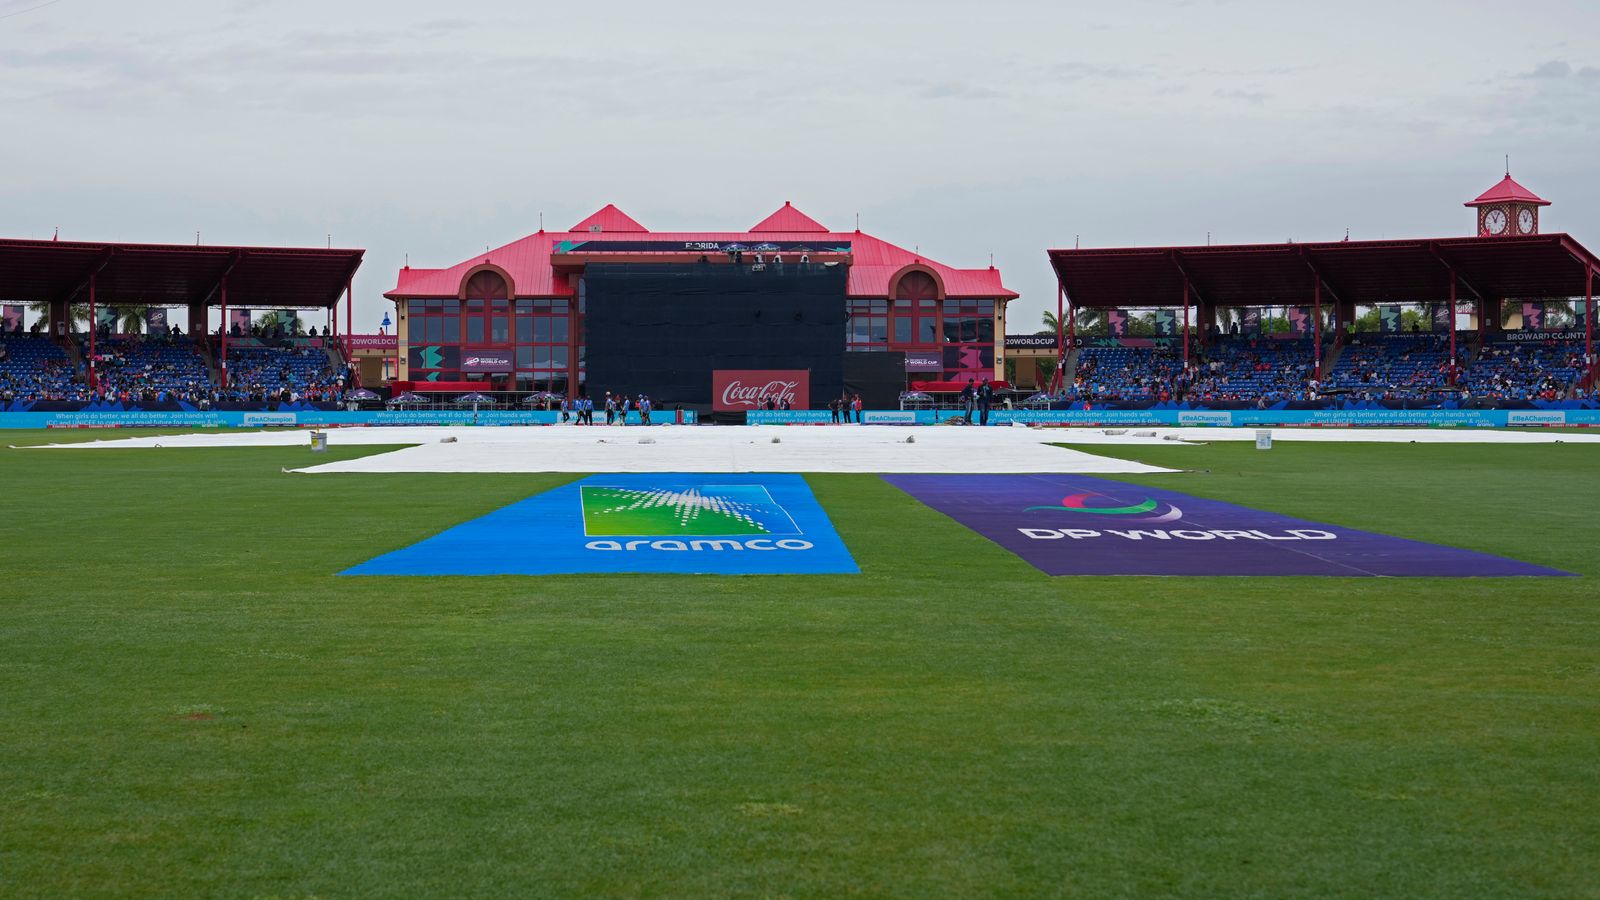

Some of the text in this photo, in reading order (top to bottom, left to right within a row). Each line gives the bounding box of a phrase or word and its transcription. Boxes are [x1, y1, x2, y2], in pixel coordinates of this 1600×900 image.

[722, 380, 799, 406] Coca-Cola
[1018, 528, 1337, 540] DP WORLD
[585, 539, 814, 551] aramco
